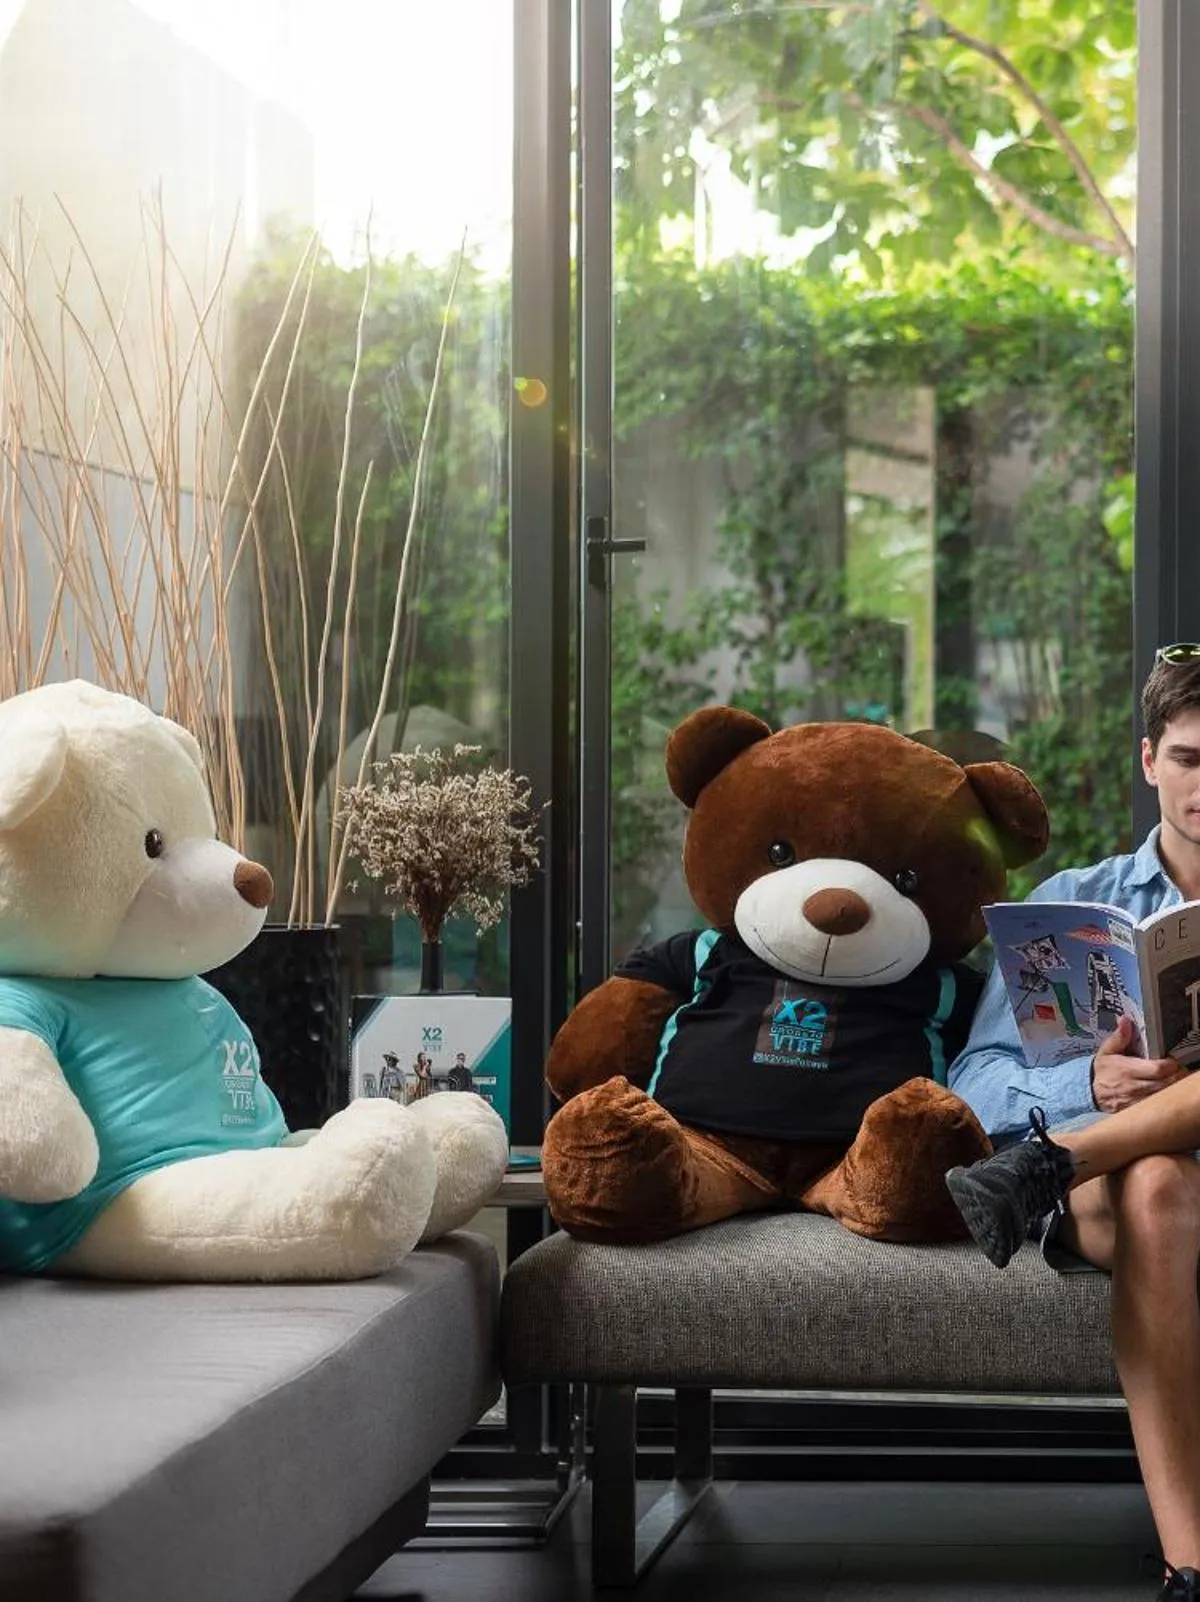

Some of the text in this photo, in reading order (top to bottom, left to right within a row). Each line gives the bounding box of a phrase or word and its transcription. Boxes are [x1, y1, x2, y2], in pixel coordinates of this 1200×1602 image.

[774, 998, 826, 1030] X2
[422, 1027, 442, 1041] X2
[769, 1033, 822, 1055] VIBE
[222, 1040, 255, 1076] X2
